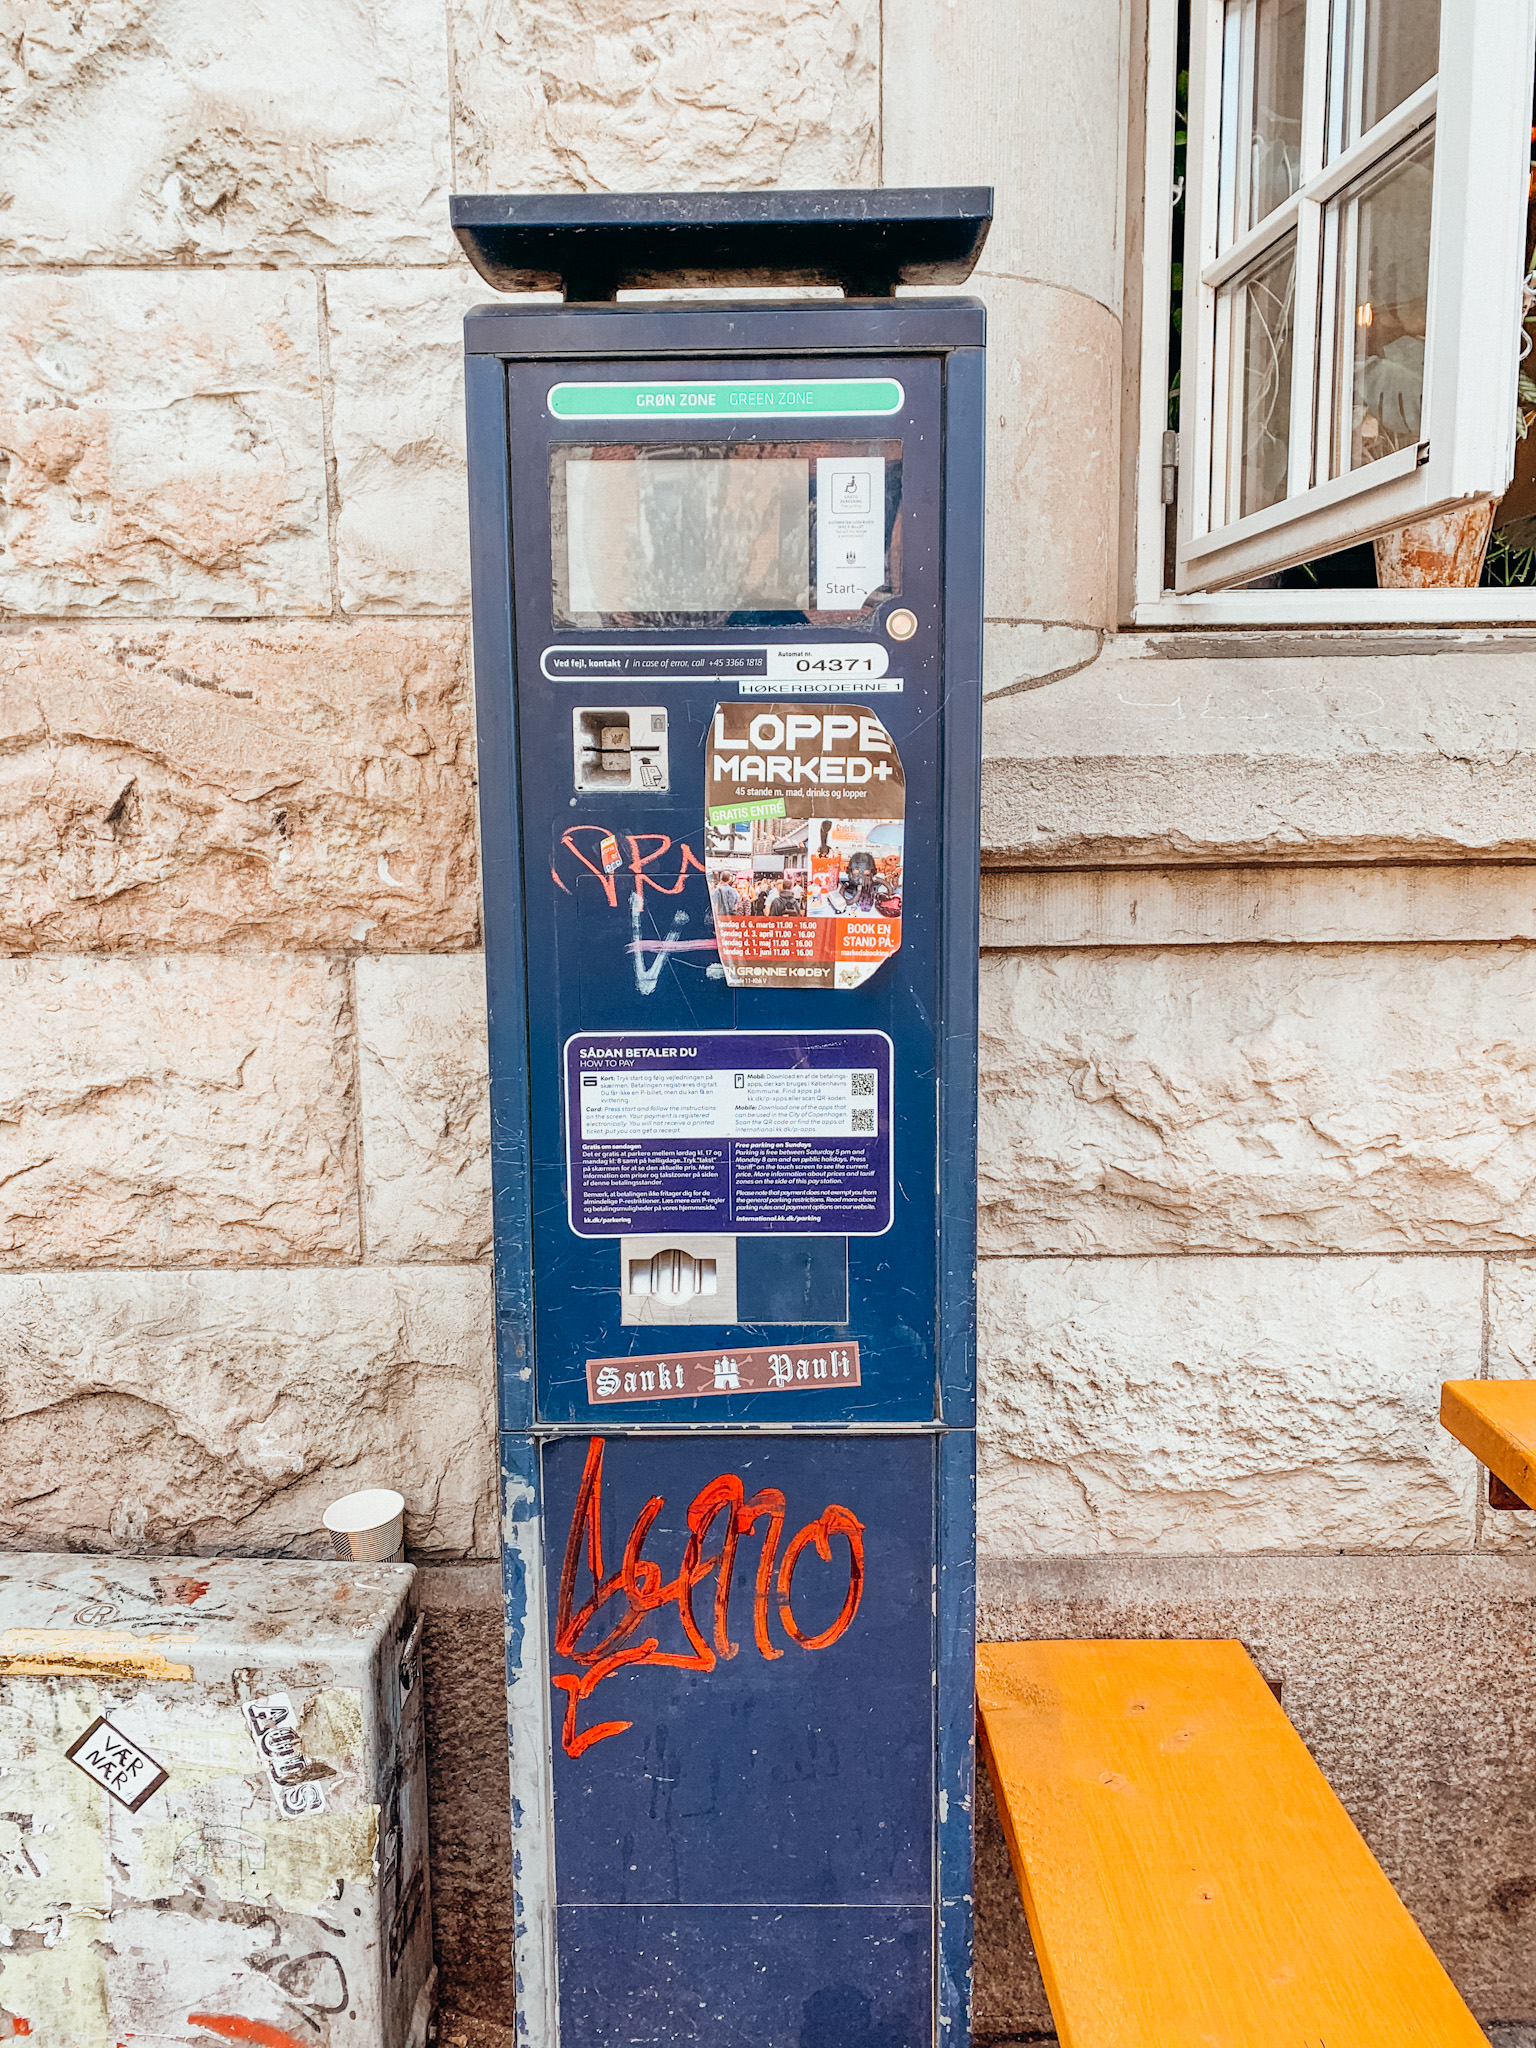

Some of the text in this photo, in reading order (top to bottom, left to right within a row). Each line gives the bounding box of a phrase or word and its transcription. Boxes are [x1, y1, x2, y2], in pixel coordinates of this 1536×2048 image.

[636, 391, 813, 407] GRØN ZONE GREEN ZONE
[826, 582, 856, 594] Start
[553, 659, 569, 667] Ved
[571, 658, 587, 669] fejl,
[589, 658, 621, 668] kontakt
[633, 658, 640, 667] in
[642, 659, 658, 667] case
[660, 658, 669, 669] of
[692, 658, 705, 667] call
[709, 658, 724, 667] +45
[725, 658, 744, 667] 3366
[746, 658, 763, 667] 1818
[796, 659, 872, 672] 04371
[742, 683, 901, 693] HØKERBODERNE 1
[713, 713, 892, 753] LOPPE
[713, 755, 893, 783] MARKED+
[735, 787, 868, 799] 45 stande m. mad, drinks og lopper
[711, 800, 784, 822] GRATIS ENTRÉ
[740, 921, 747, 929] d.
[748, 921, 755, 929] 6.
[756, 921, 775, 929] marts
[776, 921, 793, 929] 11.00
[799, 922, 817, 930] 16.00
[847, 923, 891, 935] BOOK EN
[743, 930, 750, 938] d.
[751, 930, 758, 938] 3.
[759, 930, 774, 940] april
[775, 930, 792, 938] 11.00
[798, 931, 815, 939] 16.00
[842, 934, 895, 948] STAND PÅ:
[744, 938, 751, 947] d.
[752, 939, 758, 947] 1.
[759, 939, 771, 949] maj
[772, 939, 789, 948] 11.00
[795, 940, 813, 948] 16.00
[744, 948, 751, 956] d.
[752, 948, 758, 956] 1.
[759, 948, 772, 958] juni
[773, 949, 790, 957] 11.00
[796, 949, 813, 957] 16.00
[580, 1046, 698, 1059] SÅDAN BETALER DU
[580, 1059, 635, 1068] HOW TO PAY
[785, 1141, 812, 1149] Sundays
[735, 1149, 759, 1157] Parking
[806, 1149, 834, 1157] Saturday
[735, 1156, 760, 1164] Monday
[821, 1156, 848, 1164] holidays.
[807, 1178, 819, 1186] pay
[596, 1349, 850, 1397] Sankt Pauli
[105, 1735, 144, 1777] VÆR
[85, 1750, 128, 1791] NÆR
